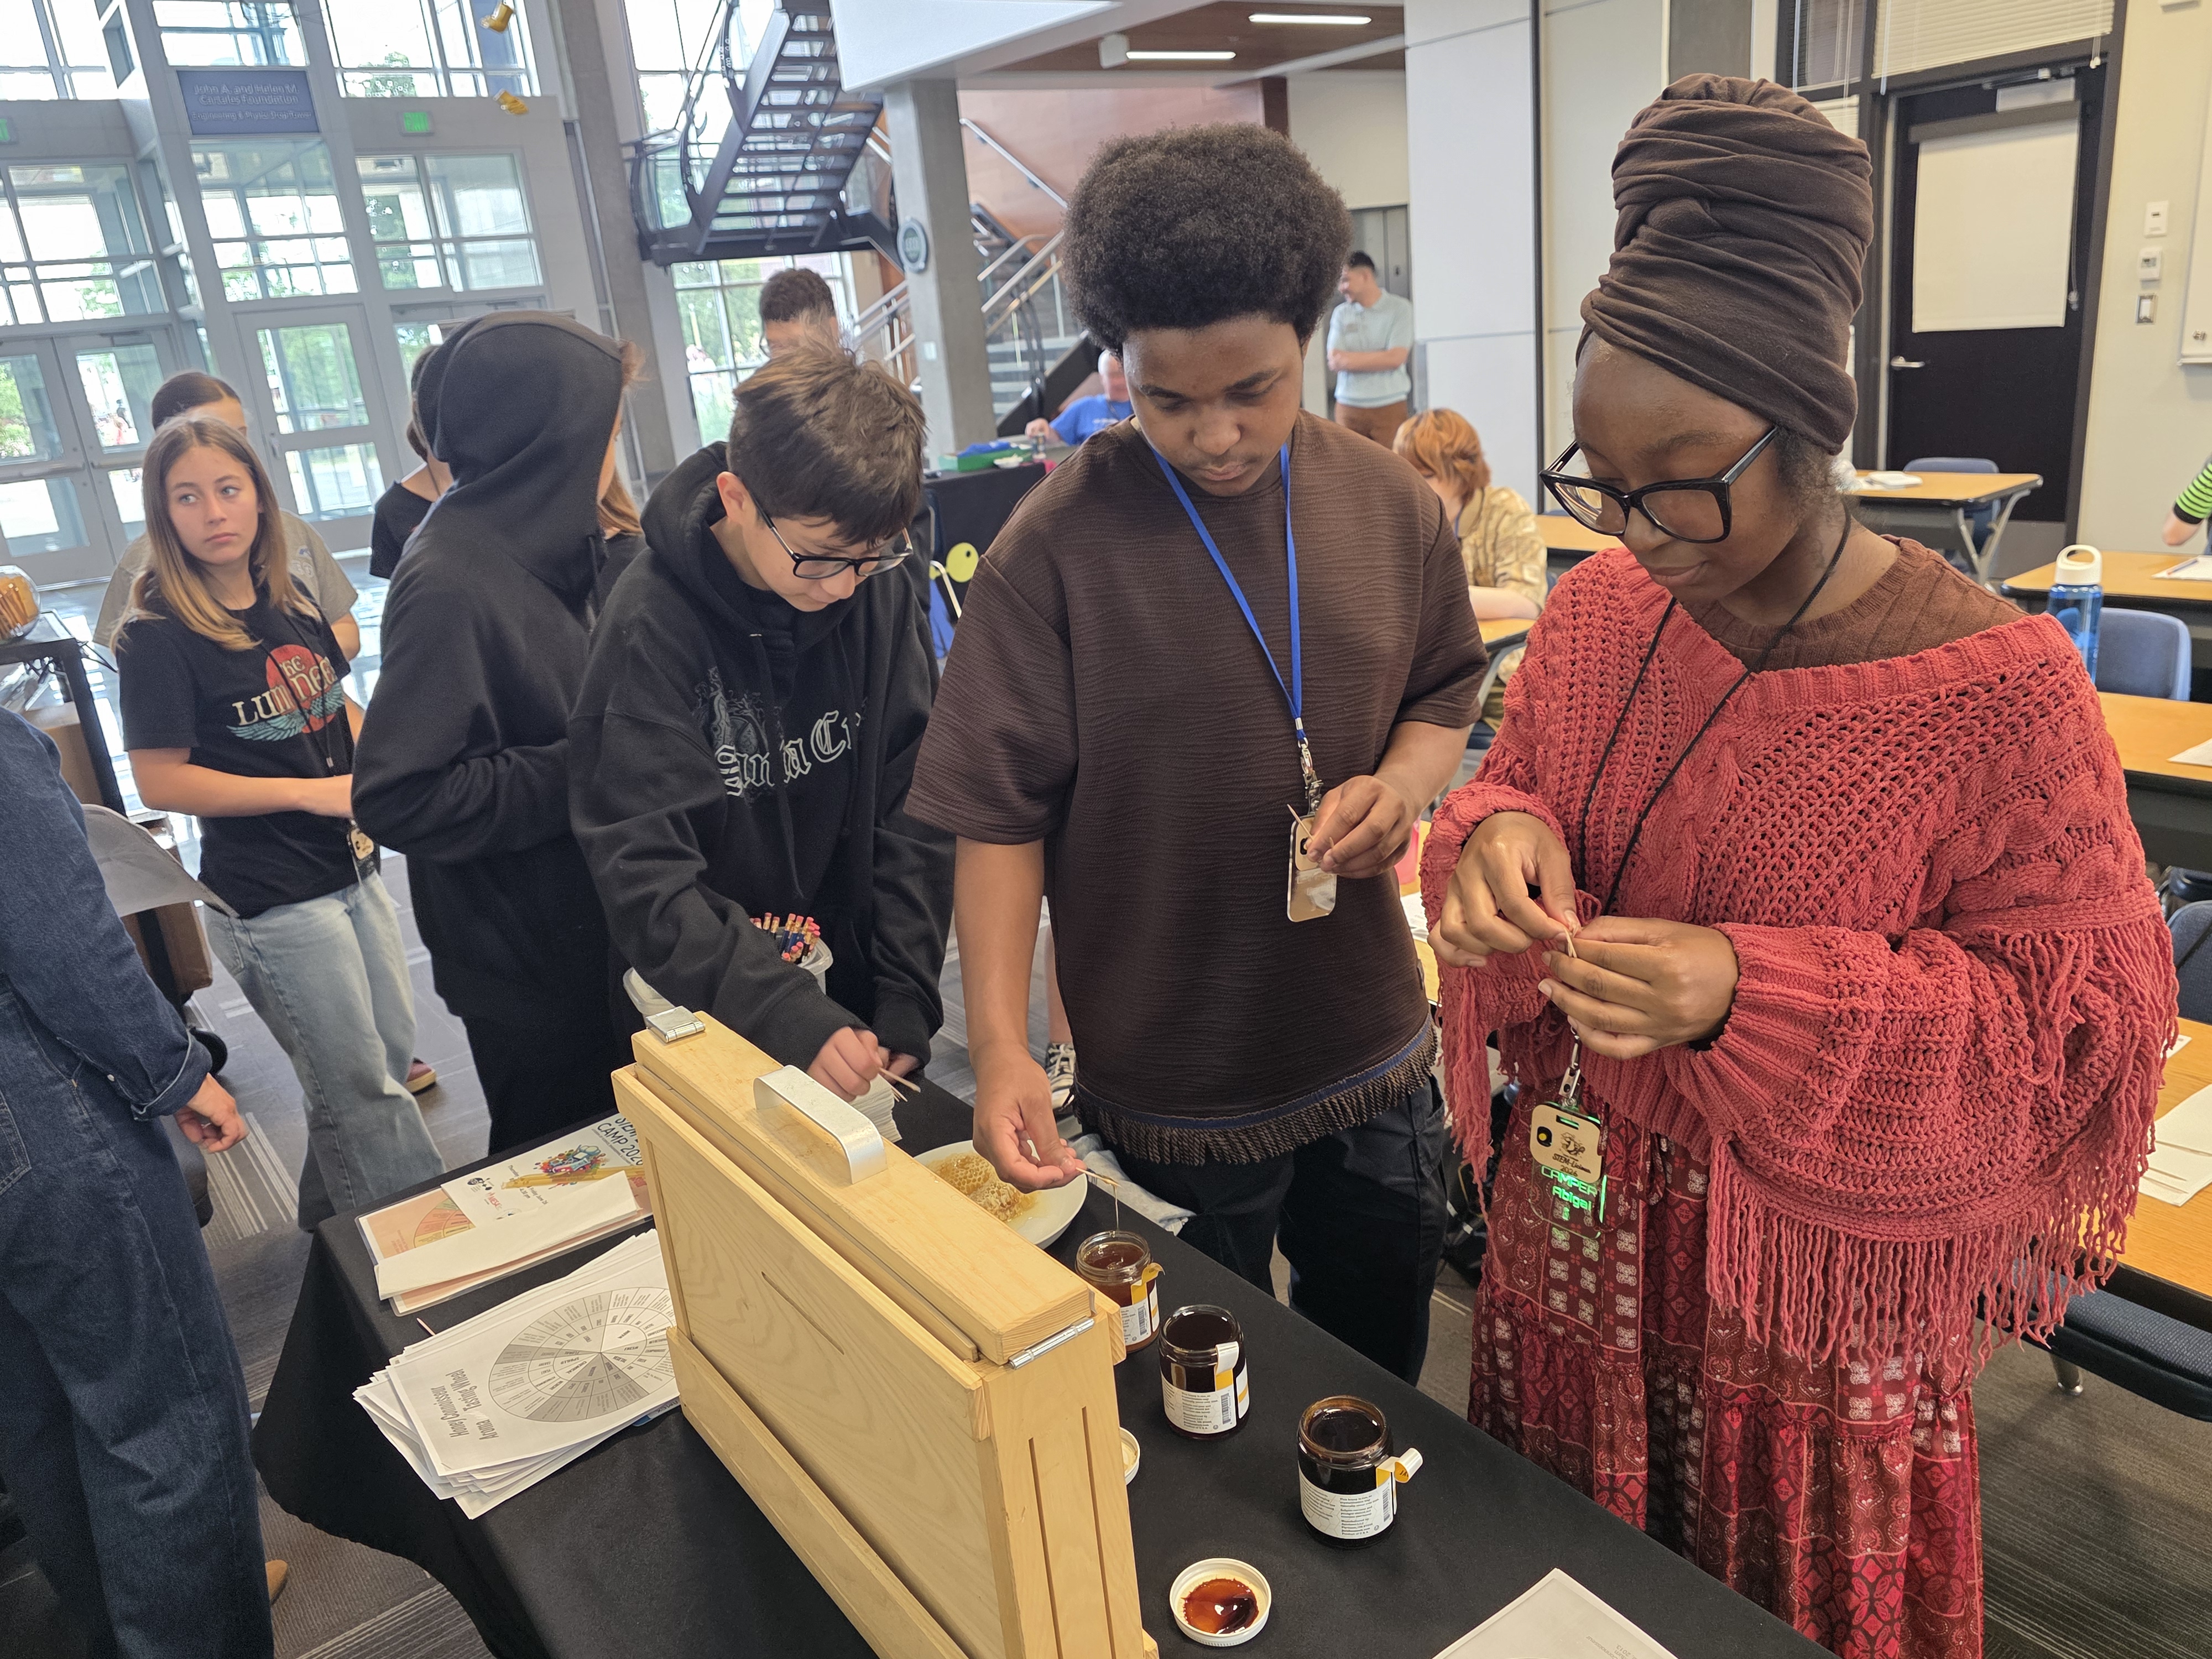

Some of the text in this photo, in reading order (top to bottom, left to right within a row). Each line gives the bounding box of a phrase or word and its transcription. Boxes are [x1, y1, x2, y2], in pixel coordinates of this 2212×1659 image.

[194, 84, 219, 95] John
[233, 84, 253, 94] and
[254, 84, 284, 95] Helen
[241, 95, 299, 105] Foundation
[597, 1123, 628, 1144] CAMP
[1541, 1165, 1598, 1197] CAMPER
[1560, 1165, 1578, 1177] 2026
[431, 1385, 469, 1437] Honey Connoisseur
[445, 1369, 499, 1440] Aroma Tasting Wheel
